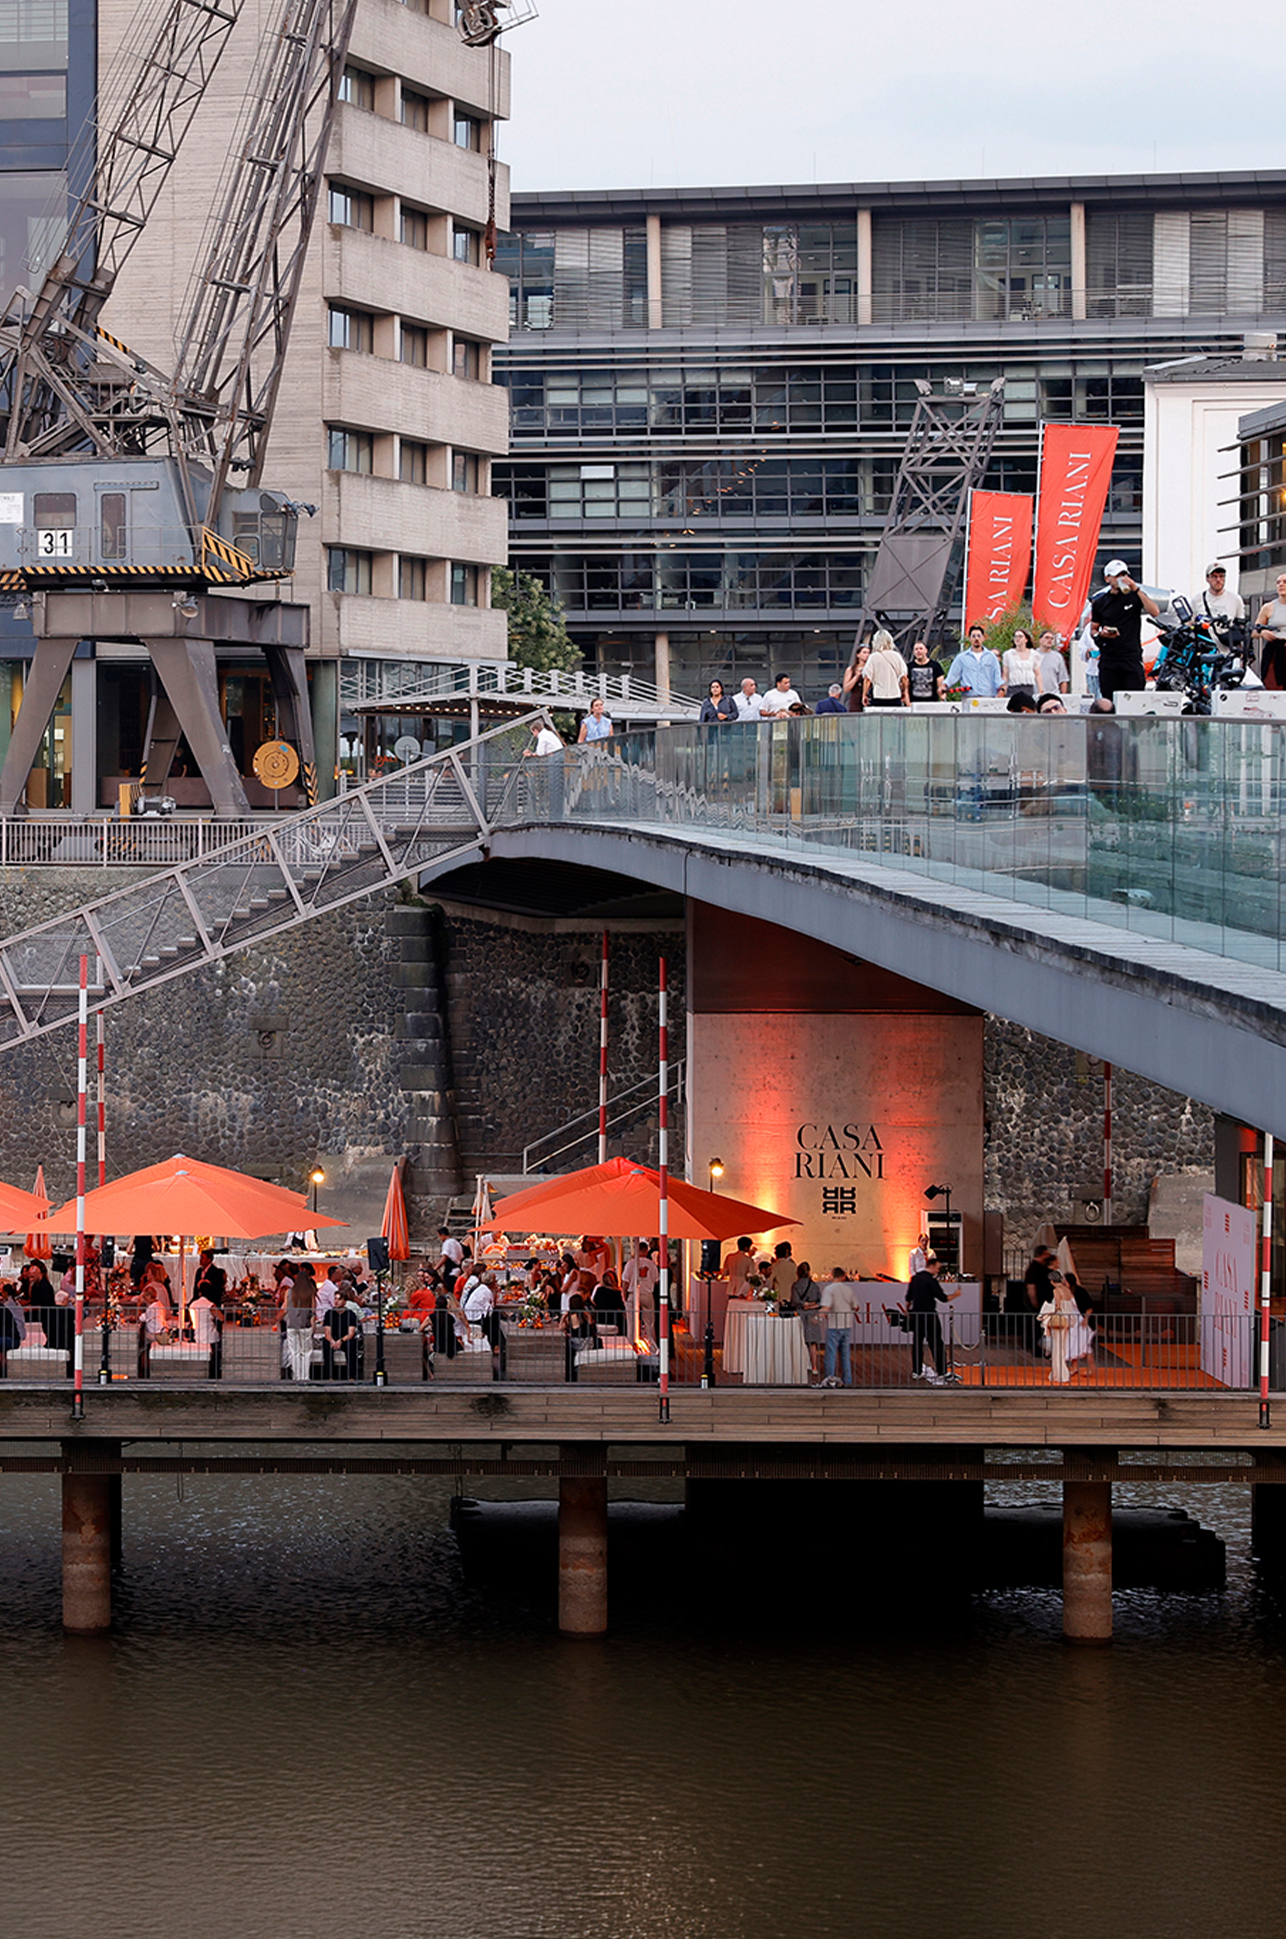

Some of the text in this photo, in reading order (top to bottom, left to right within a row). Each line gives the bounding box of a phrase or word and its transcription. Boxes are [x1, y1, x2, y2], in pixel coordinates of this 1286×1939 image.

[44, 532, 67, 554] 31
[1047, 453, 1092, 608] CASA RIANI
[989, 516, 1014, 583] RIANI
[797, 1123, 883, 1150] CASA
[795, 1152, 884, 1178] RIANI
